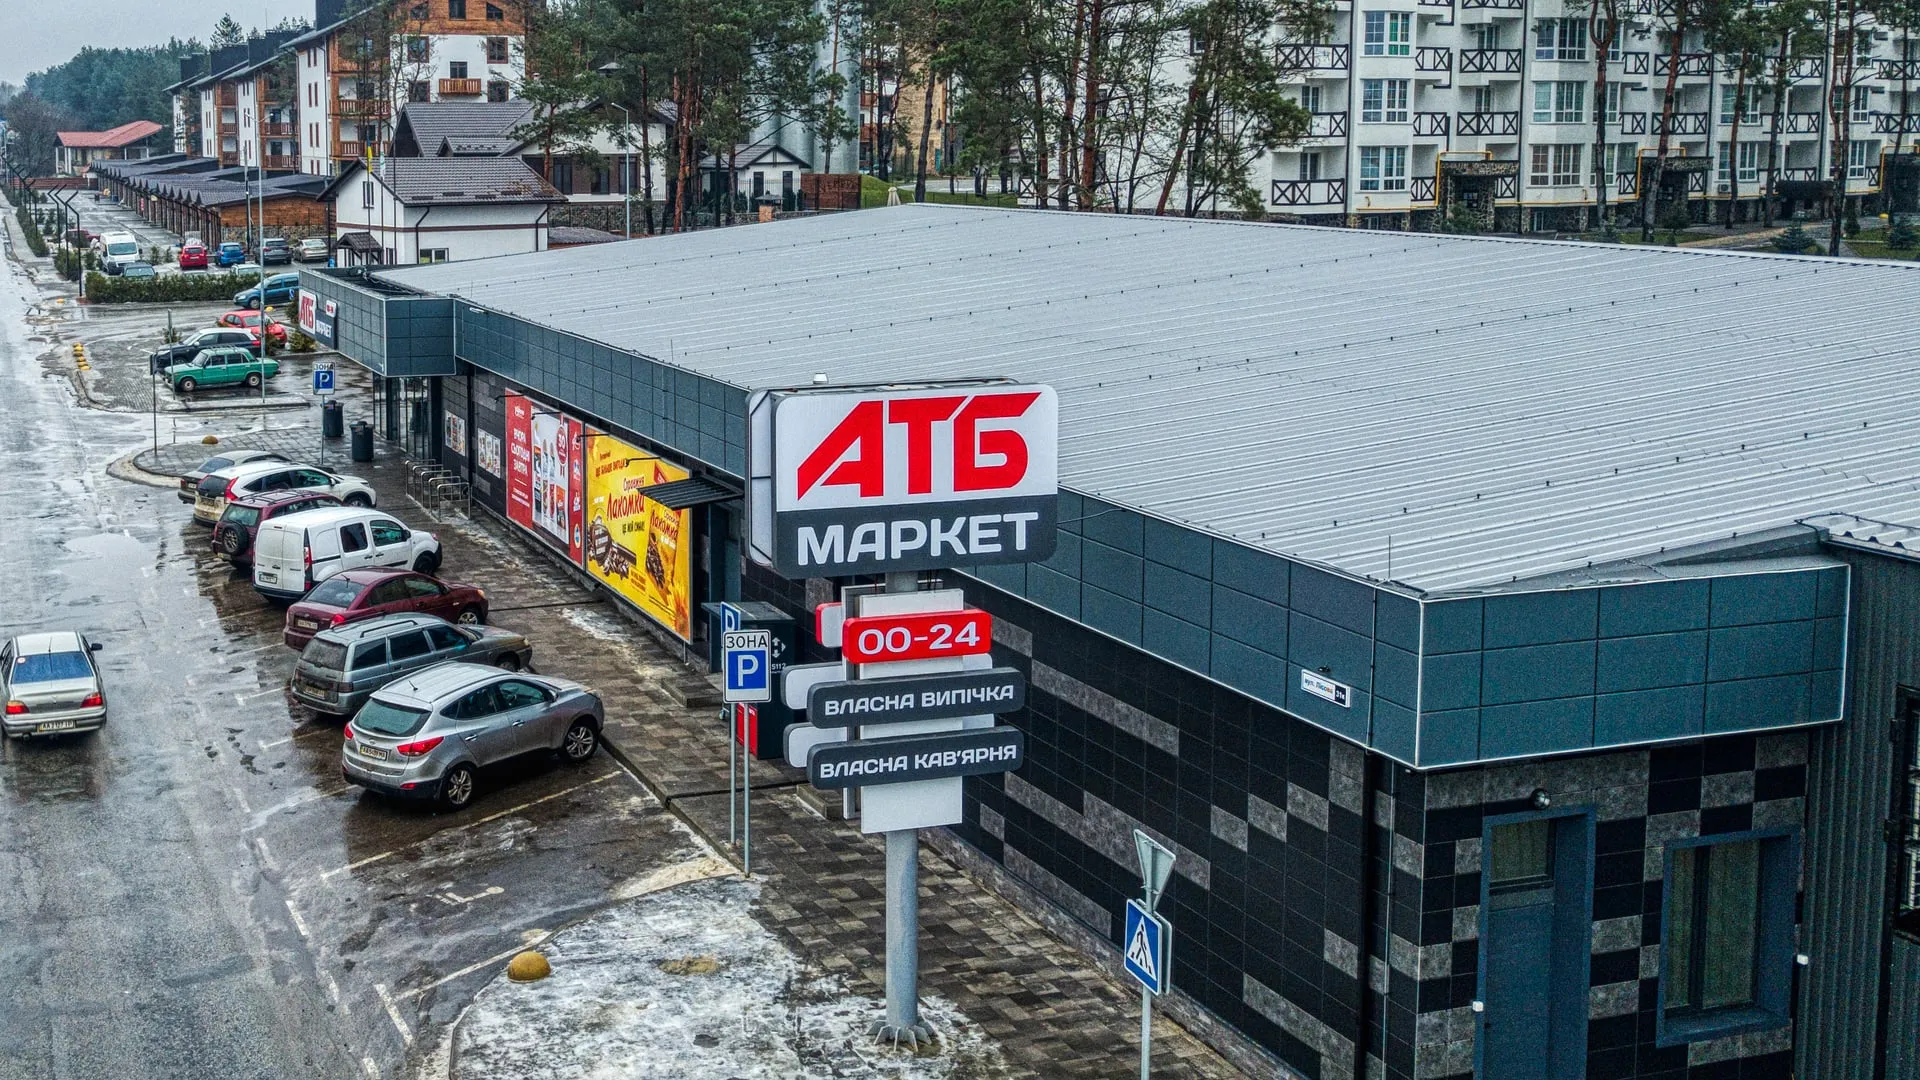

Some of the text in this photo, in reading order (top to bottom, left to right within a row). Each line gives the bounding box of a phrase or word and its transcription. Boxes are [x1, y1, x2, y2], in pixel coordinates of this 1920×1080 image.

[797, 391, 1043, 500] АТБ
[606, 493, 645, 521] Лакомка
[797, 512, 1039, 567] МАРКЕТ
[726, 634, 768, 649] ЗОНА
[858, 620, 981, 656] 00-24
[824, 684, 1015, 716] ВЛАСНА ВИПІЧКА
[820, 743, 1017, 780] ВЛАСНА КАВ'ЯРНЯ
